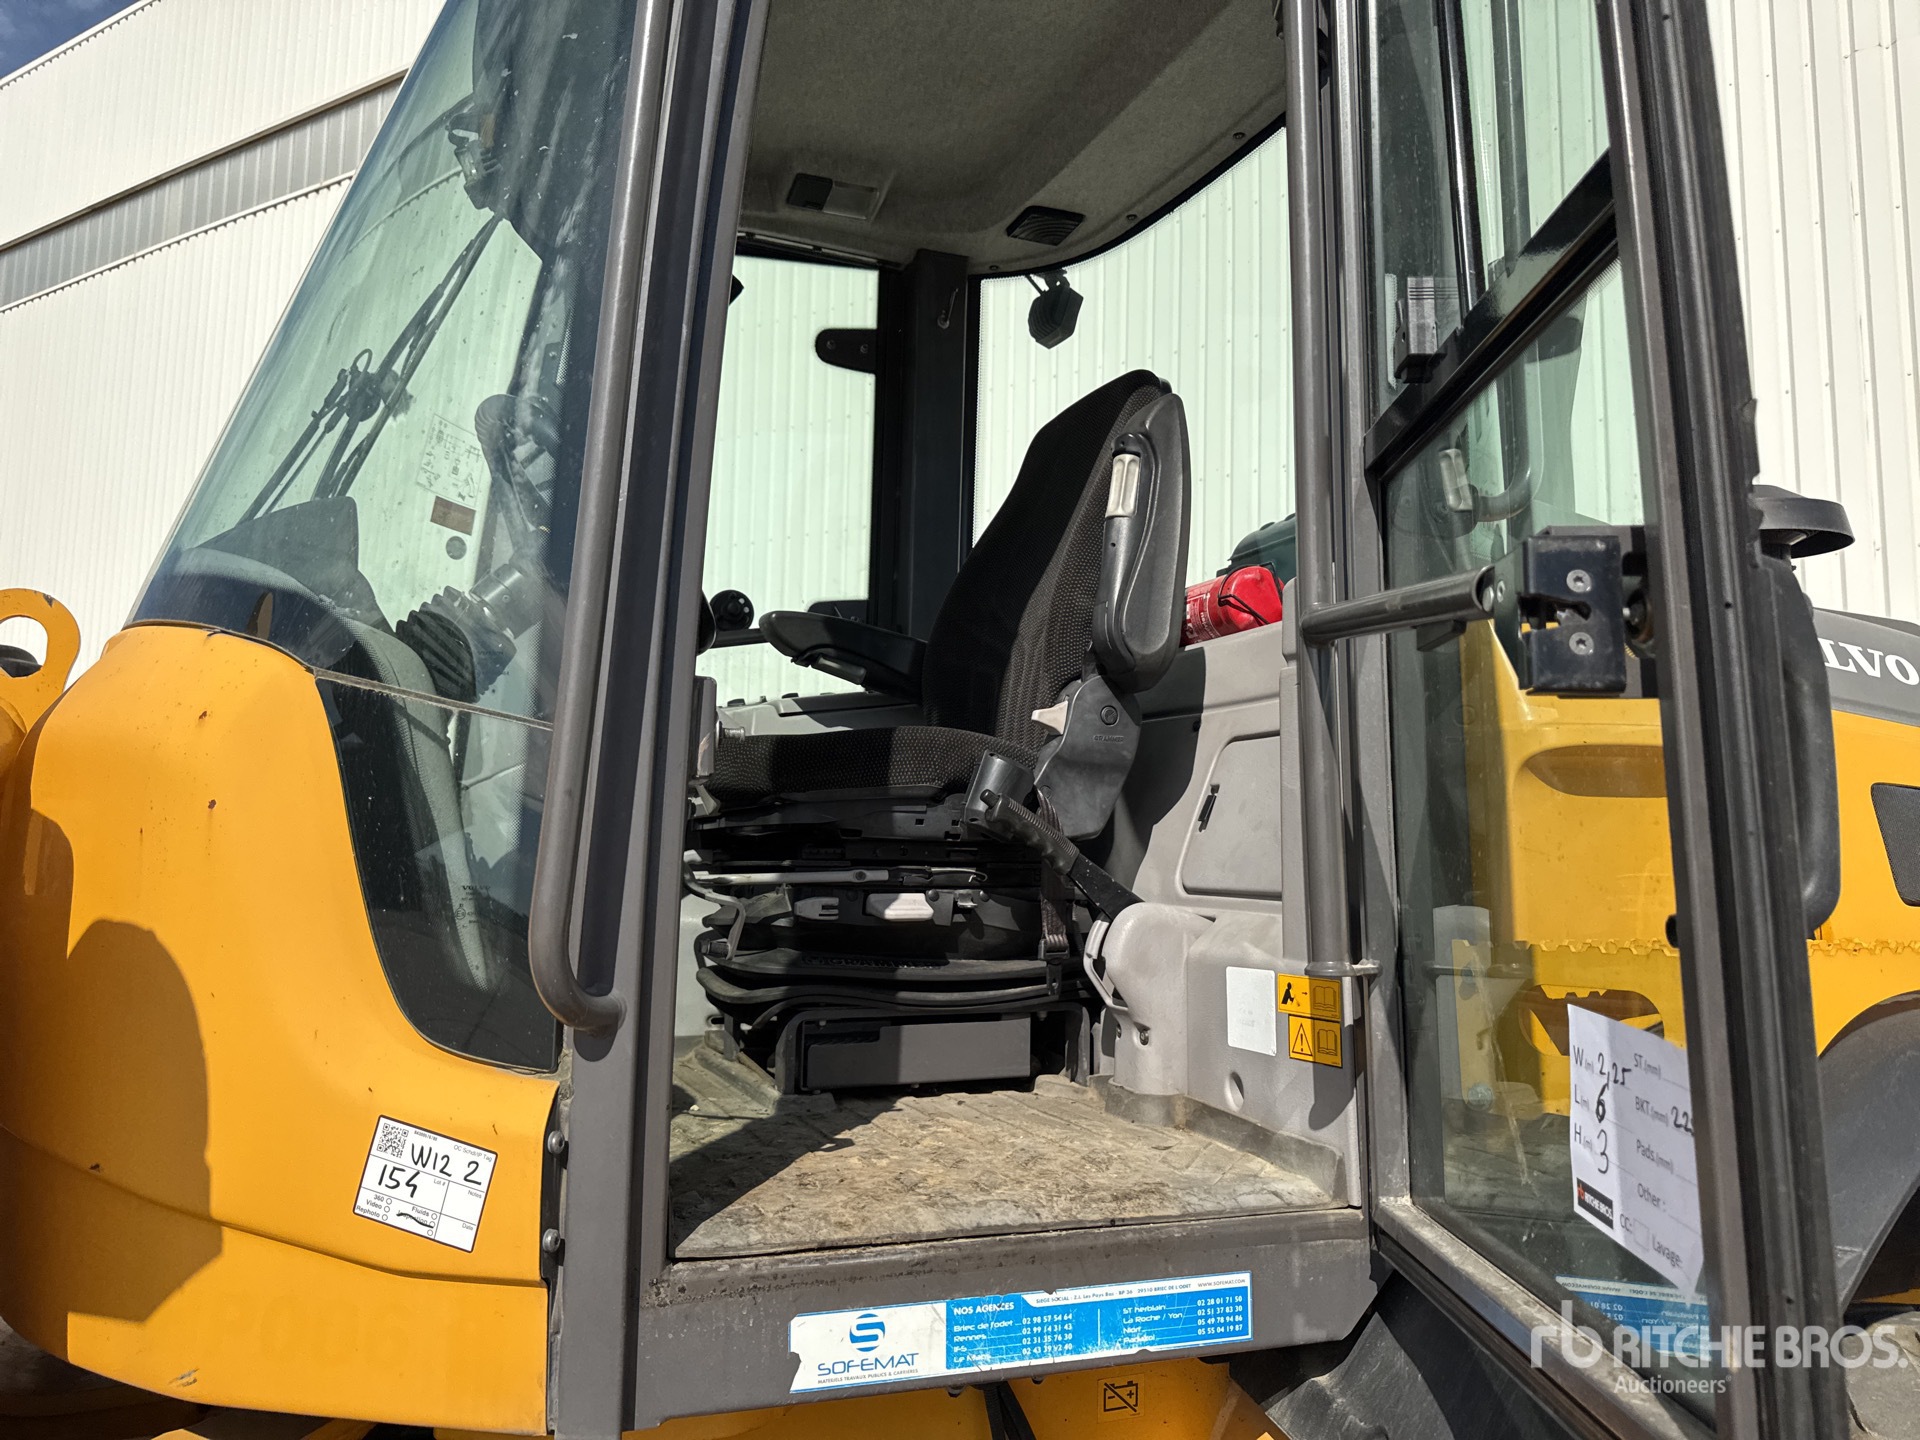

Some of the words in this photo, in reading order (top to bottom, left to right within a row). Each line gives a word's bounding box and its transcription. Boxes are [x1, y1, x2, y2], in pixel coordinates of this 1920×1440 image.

[1818, 637, 1920, 686] LVO
[1573, 1045, 1584, 1067] W
[1574, 1084, 1581, 1105] L
[1595, 1082, 1608, 1124] 6
[1635, 1095, 1650, 1116] BKT
[1670, 1105, 1694, 1138] 22
[1574, 1122, 1582, 1144] H
[1597, 1129, 1609, 1174] 3
[378, 1164, 420, 1199] 154
[464, 1160, 482, 1186] 2
[468, 1190, 482, 1199] Notes
[356, 1205, 381, 1218] Rephoto
[366, 1199, 382, 1210] Video
[412, 1206, 430, 1217] Fluids
[462, 1222, 474, 1231] Date
[953, 1306, 973, 1316] NOS
[975, 1302, 1015, 1313] AGENCES
[953, 1324, 975, 1332] Briec
[977, 1322, 988, 1330] de
[1022, 1317, 1031, 1325] 02
[1033, 1316, 1041, 1324] 98
[1135, 1315, 1160, 1323] Roche
[953, 1334, 987, 1342] Rennes
[1022, 1327, 1031, 1335] 02
[1033, 1326, 1041, 1334] 99
[1063, 1323, 1073, 1331] 43
[1234, 1324, 1243, 1332] 87
[1022, 1337, 1031, 1345] 02
[1033, 1336, 1041, 1344] 31
[1043, 1335, 1051, 1343] 35
[1022, 1347, 1031, 1355] 02
[1033, 1346, 1041, 1354] 43
[1043, 1345, 1051, 1353] 39
[817, 1352, 919, 1377] SOFEMAT
[867, 1371, 887, 1379] PUBLICS
